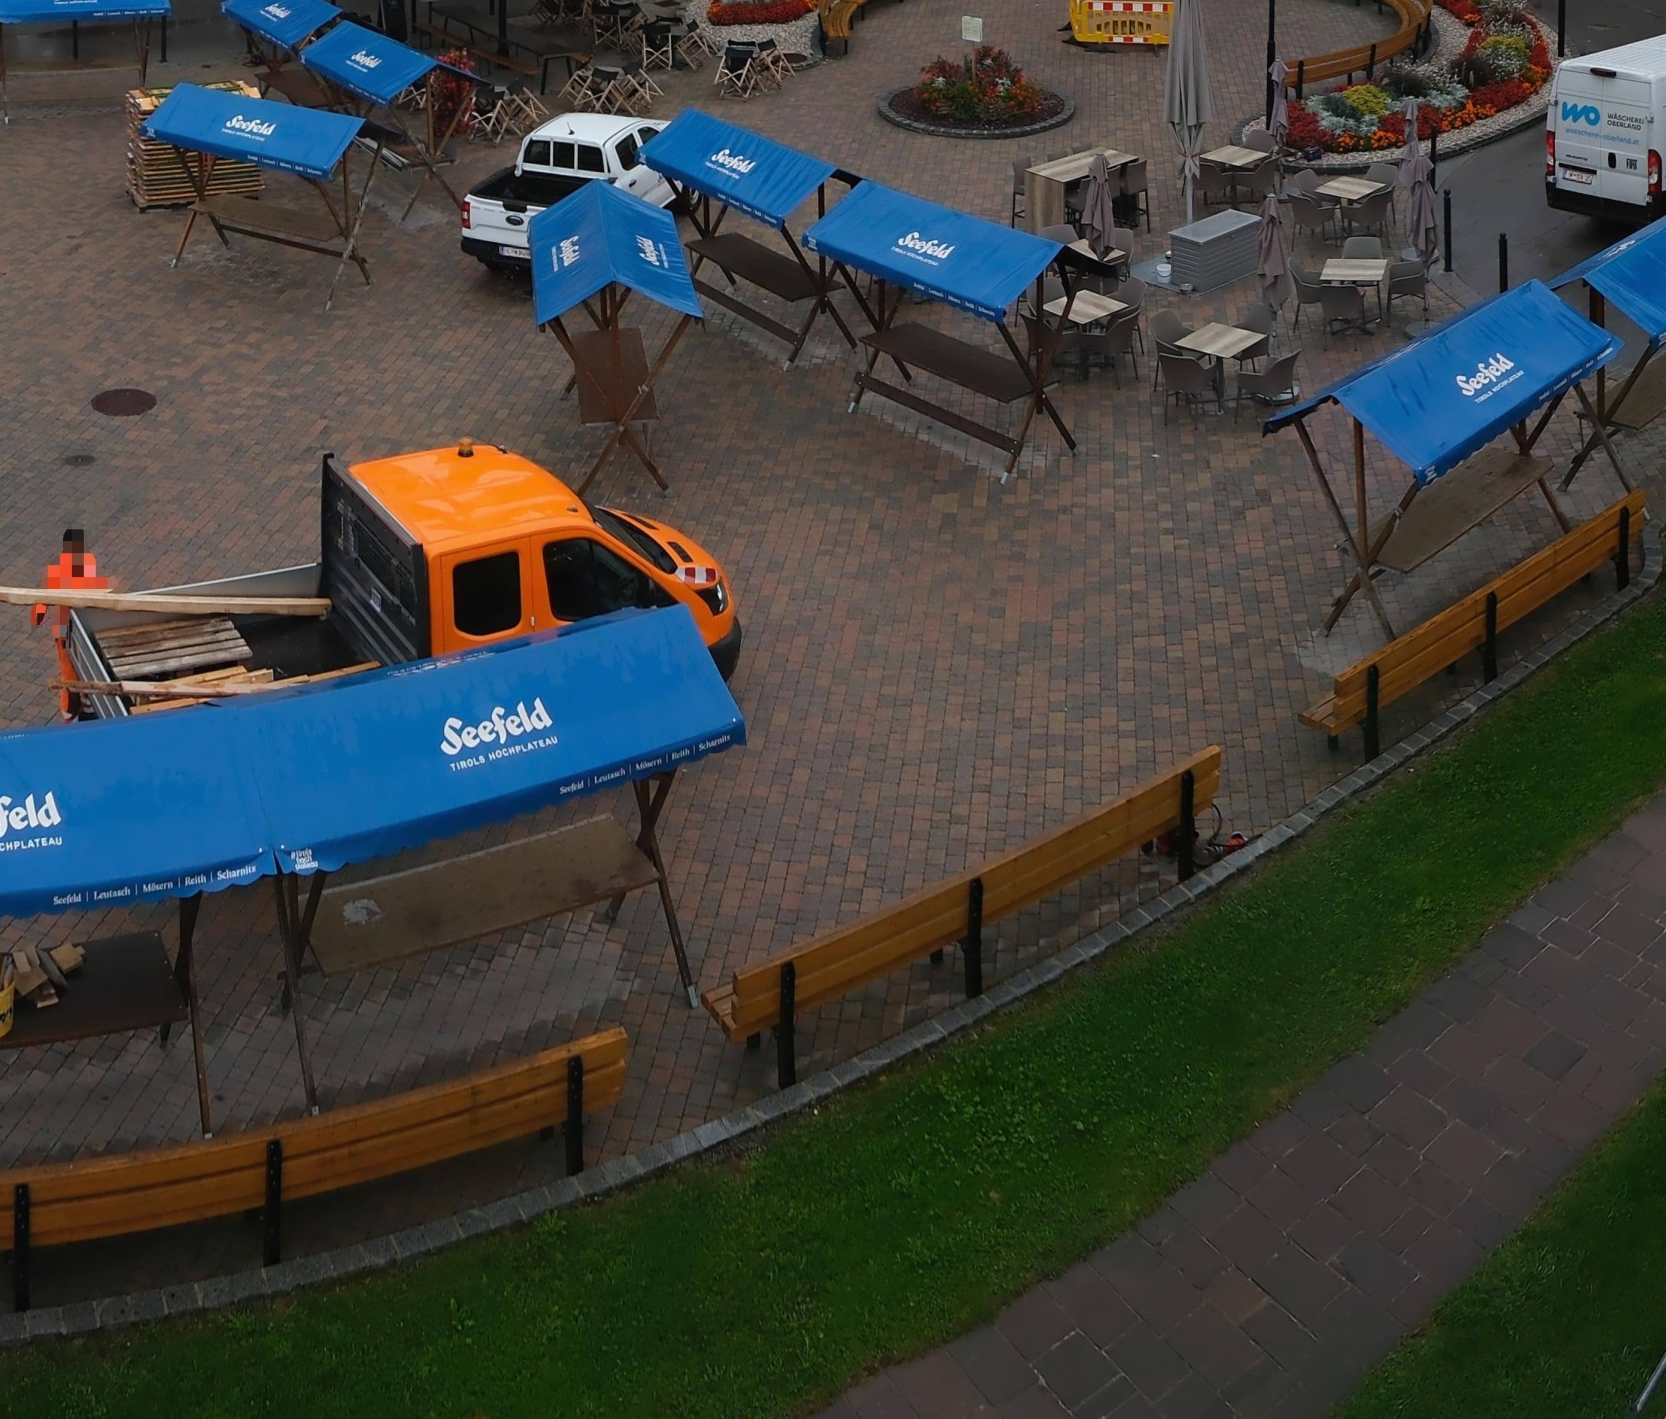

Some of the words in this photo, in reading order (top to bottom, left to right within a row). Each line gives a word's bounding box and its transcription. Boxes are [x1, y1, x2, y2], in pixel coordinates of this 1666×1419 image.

[226, 115, 277, 136] Seefeld
[1607, 112, 1645, 125] WÄSCHEREI
[1607, 119, 1642, 131] OBERLAND
[1565, 127, 1640, 146] waescherei-oberland.at
[711, 147, 758, 175] Seefeld
[898, 232, 956, 259] Seefeld
[1456, 353, 1515, 397] Seefeld
[440, 697, 553, 756] Seefeld
[450, 755, 486, 772] TIROLS
[489, 735, 559, 761] HOCHPLATEAU
[559, 780, 585, 795] Seefeld
[594, 767, 626, 785] Leutasch
[636, 757, 663, 771] Mösern
[671, 747, 690, 761] Reith
[699, 733, 731, 752] Scharnitz
[53, 891, 82, 905] Seefeld
[93, 886, 131, 901] Leutasch
[143, 879, 173, 893] Mösern
[185, 873, 207, 887] Reith
[217, 864, 256, 881] Scharnitz
